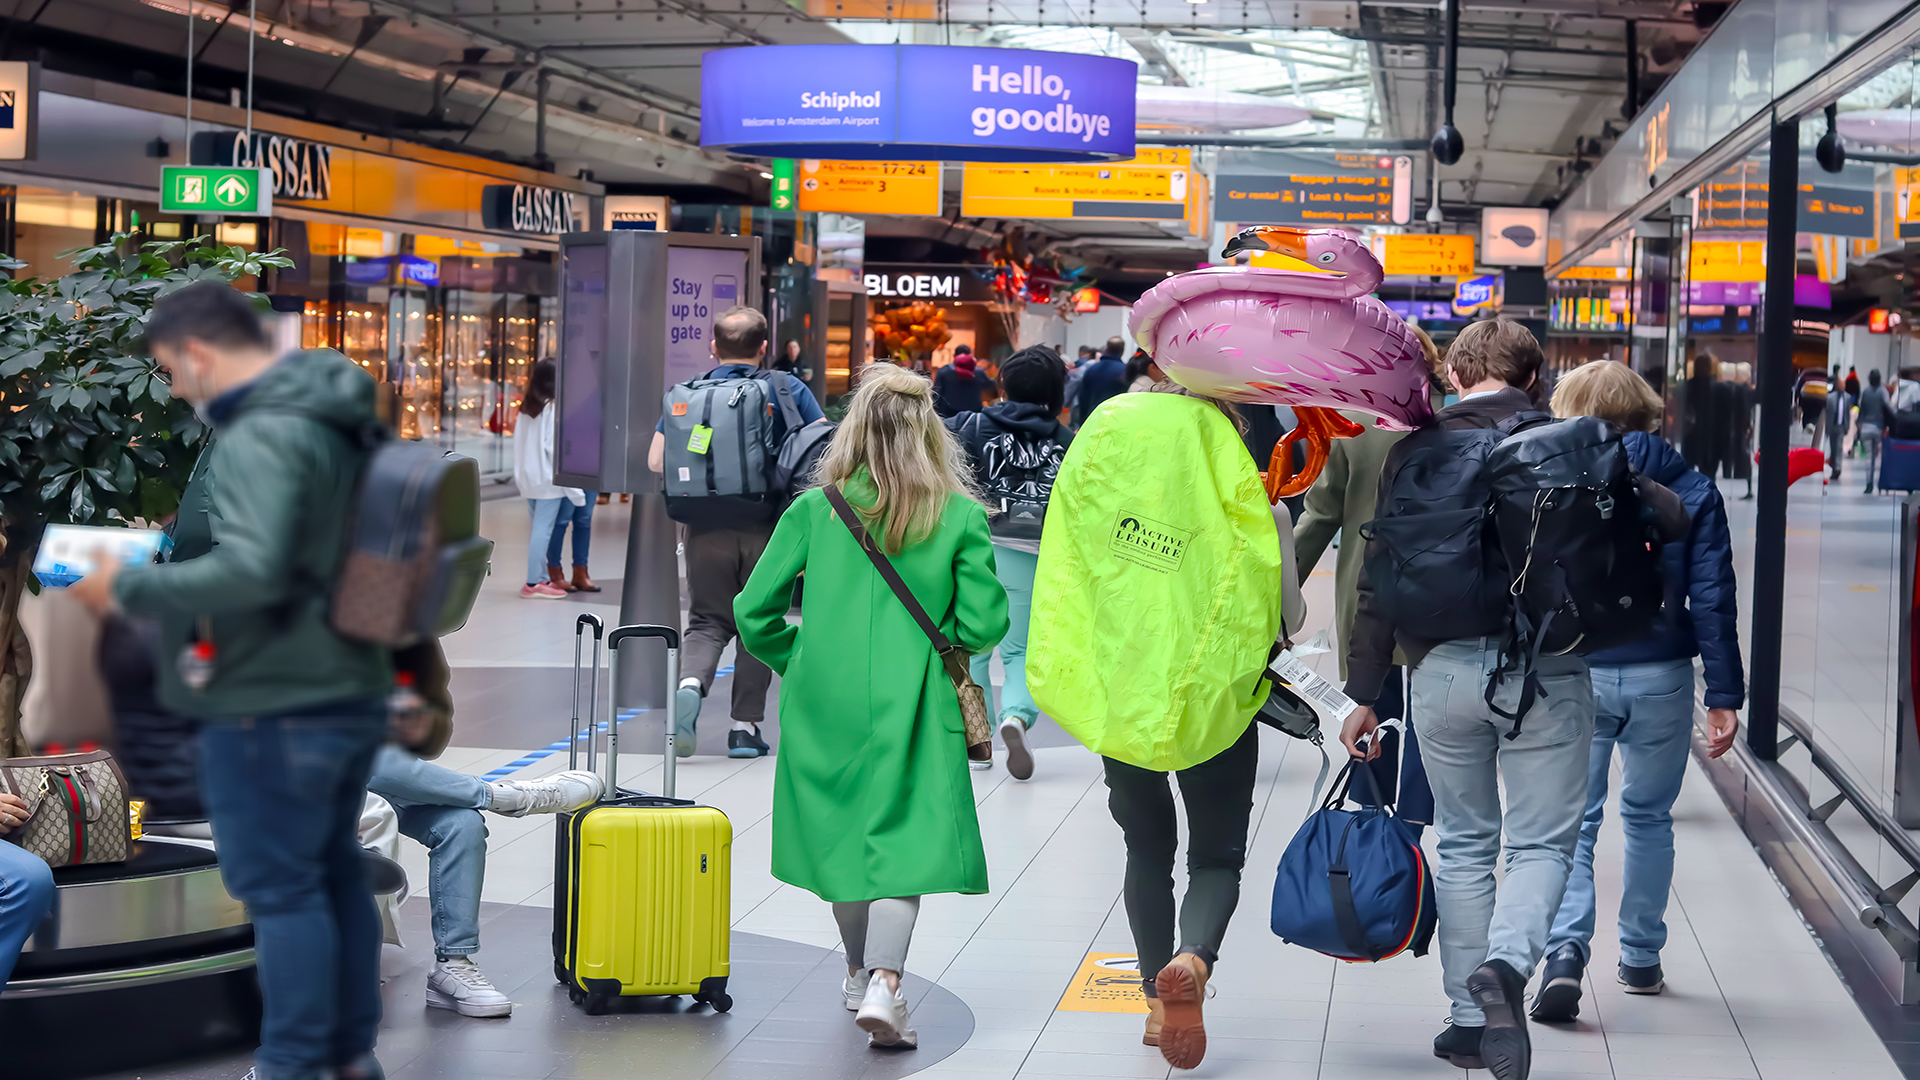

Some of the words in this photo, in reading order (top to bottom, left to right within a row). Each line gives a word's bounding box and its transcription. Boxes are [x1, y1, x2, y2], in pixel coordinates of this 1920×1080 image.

[971, 64, 1071, 101] Hello,
[800, 90, 881, 112] Schiphol
[741, 117, 775, 127] Welcome
[776, 117, 786, 126] to
[787, 116, 841, 126] Amsterdam
[842, 116, 880, 127] Airport
[971, 104, 1111, 143] goodbye
[232, 130, 332, 200] GASSAN
[1156, 152, 1179, 164] 1-2
[882, 163, 926, 175] 17-24
[838, 178, 874, 186] Arrivals
[878, 180, 886, 192] 3
[1290, 175, 1334, 185] Baggage
[1337, 176, 1375, 186] storage
[1228, 190, 1247, 200] Car
[1248, 191, 1280, 200] rental
[1309, 192, 1332, 201] Lost
[1344, 192, 1375, 202] found
[512, 184, 574, 234] GASSAN
[1302, 210, 1345, 221] Meeting
[1346, 211, 1375, 221] point
[1428, 238, 1445, 247] 1-2
[1439, 250, 1456, 260] 1-2
[1447, 264, 1470, 273] 1-16
[671, 278, 702, 299] Stay
[863, 274, 961, 298] BLOEM!
[671, 303, 690, 321] up
[693, 301, 708, 318] to
[670, 324, 702, 344] gate
[1116, 530, 1182, 559] LEISURE
[1139, 528, 1185, 549] ACTIVE
